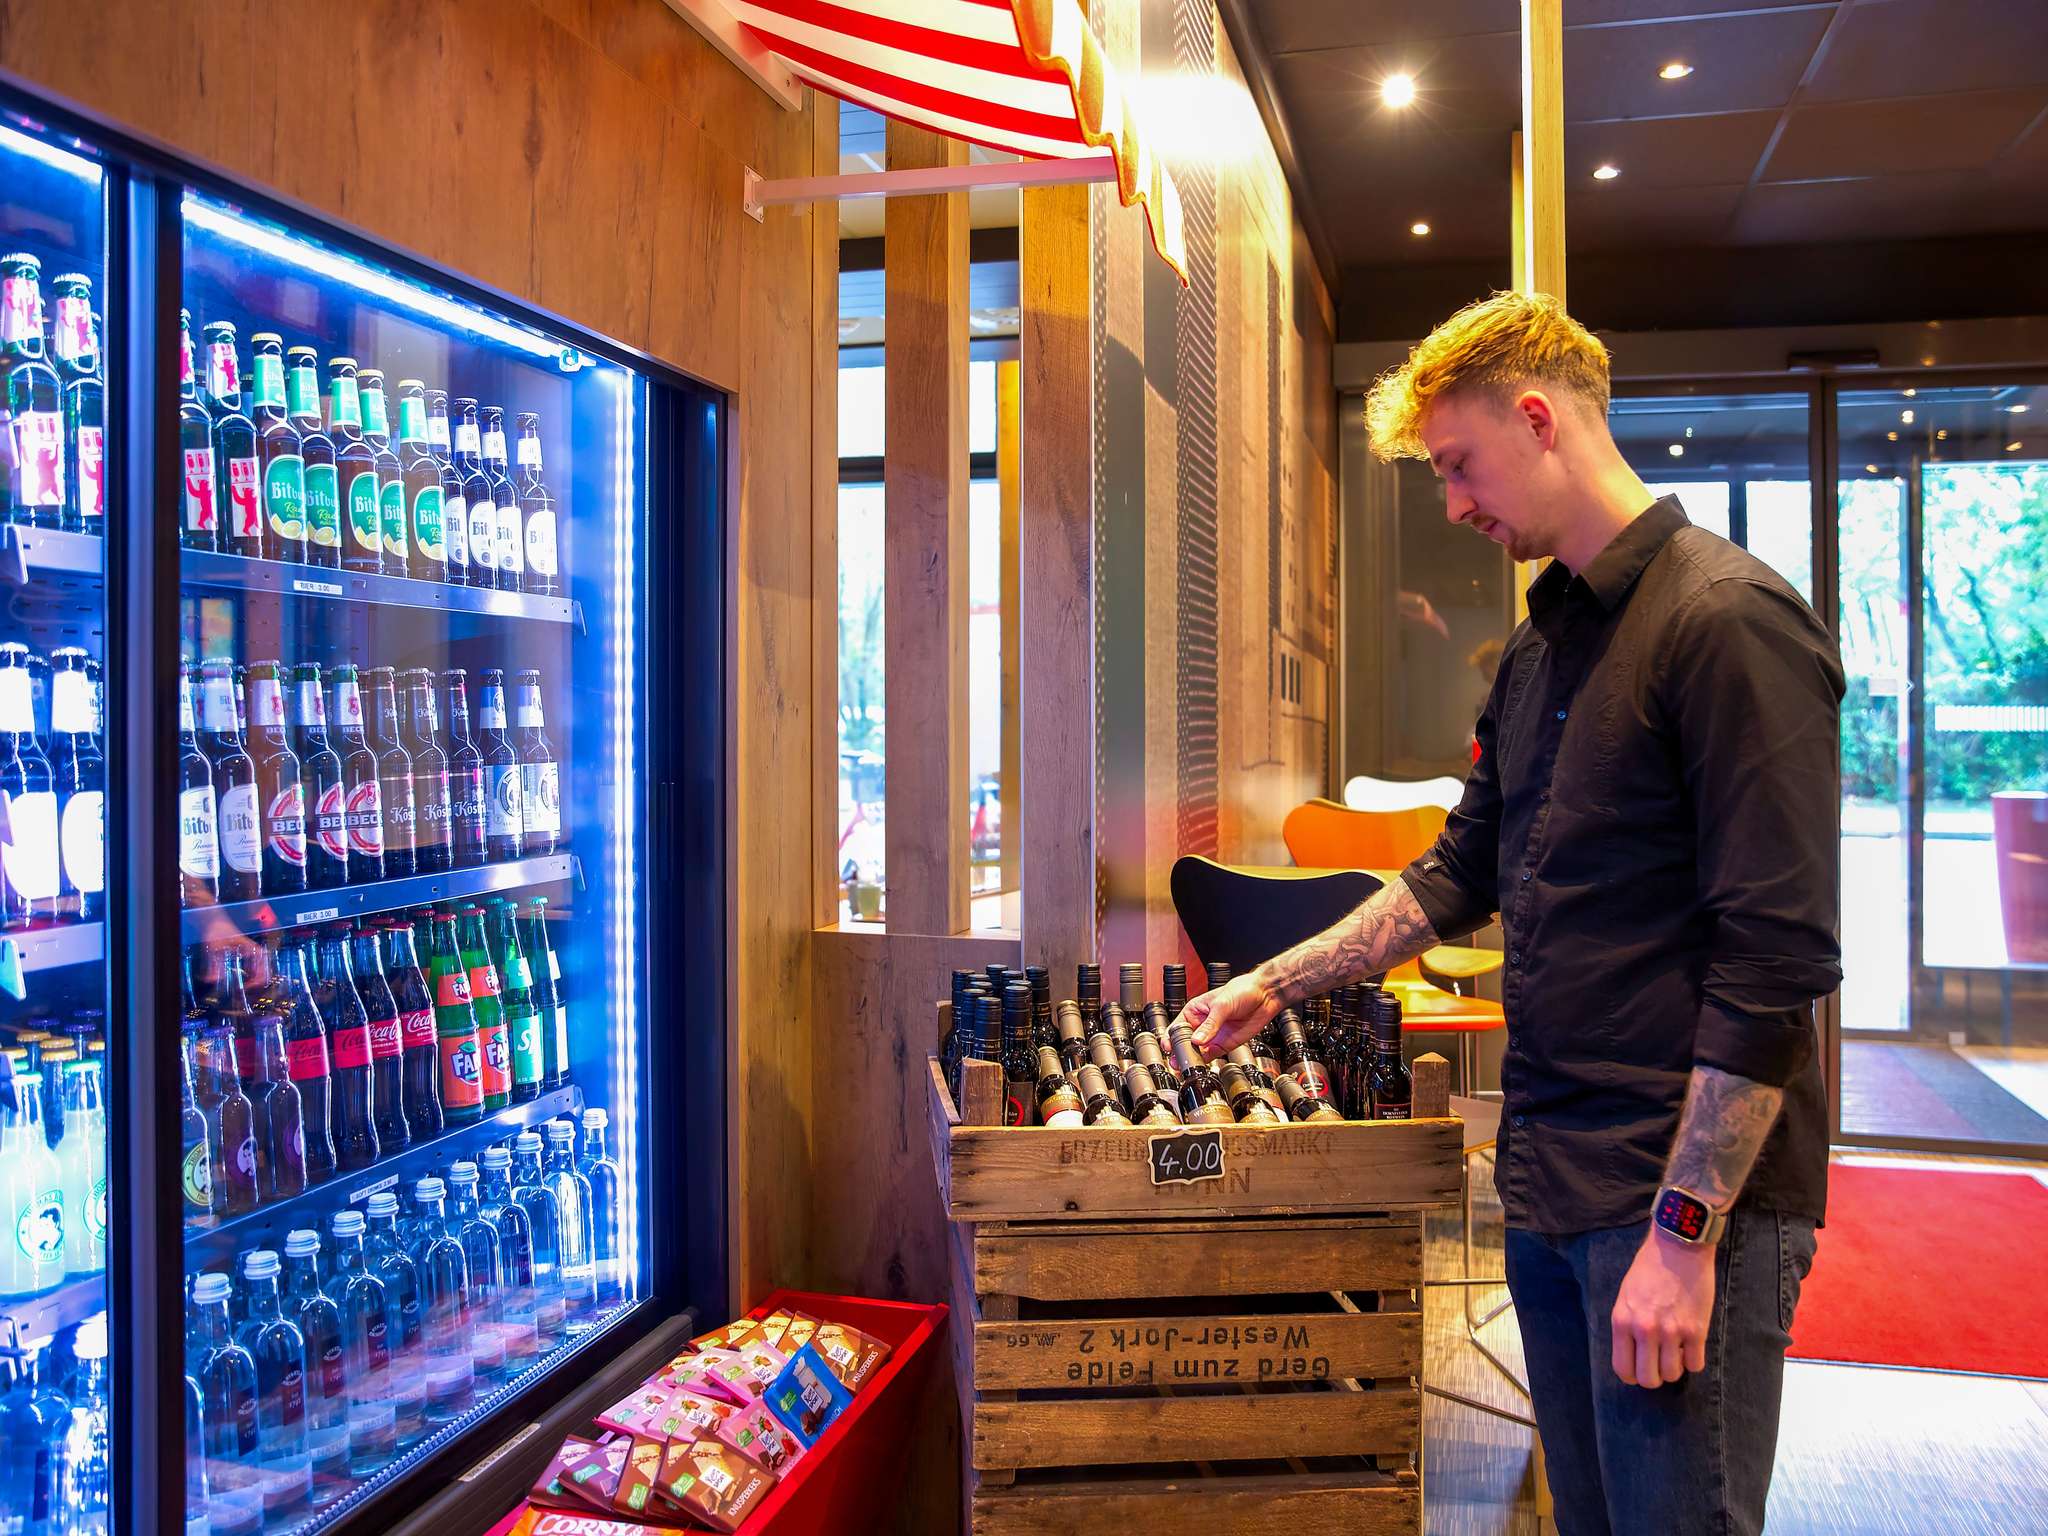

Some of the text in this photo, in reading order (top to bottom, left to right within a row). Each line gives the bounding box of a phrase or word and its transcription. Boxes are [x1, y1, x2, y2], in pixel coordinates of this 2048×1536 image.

[1078, 1329, 1096, 1353] 2
[1110, 1325, 1310, 1353] Wester-Jork
[1066, 1355, 1331, 1385] Gerd zum Felde
